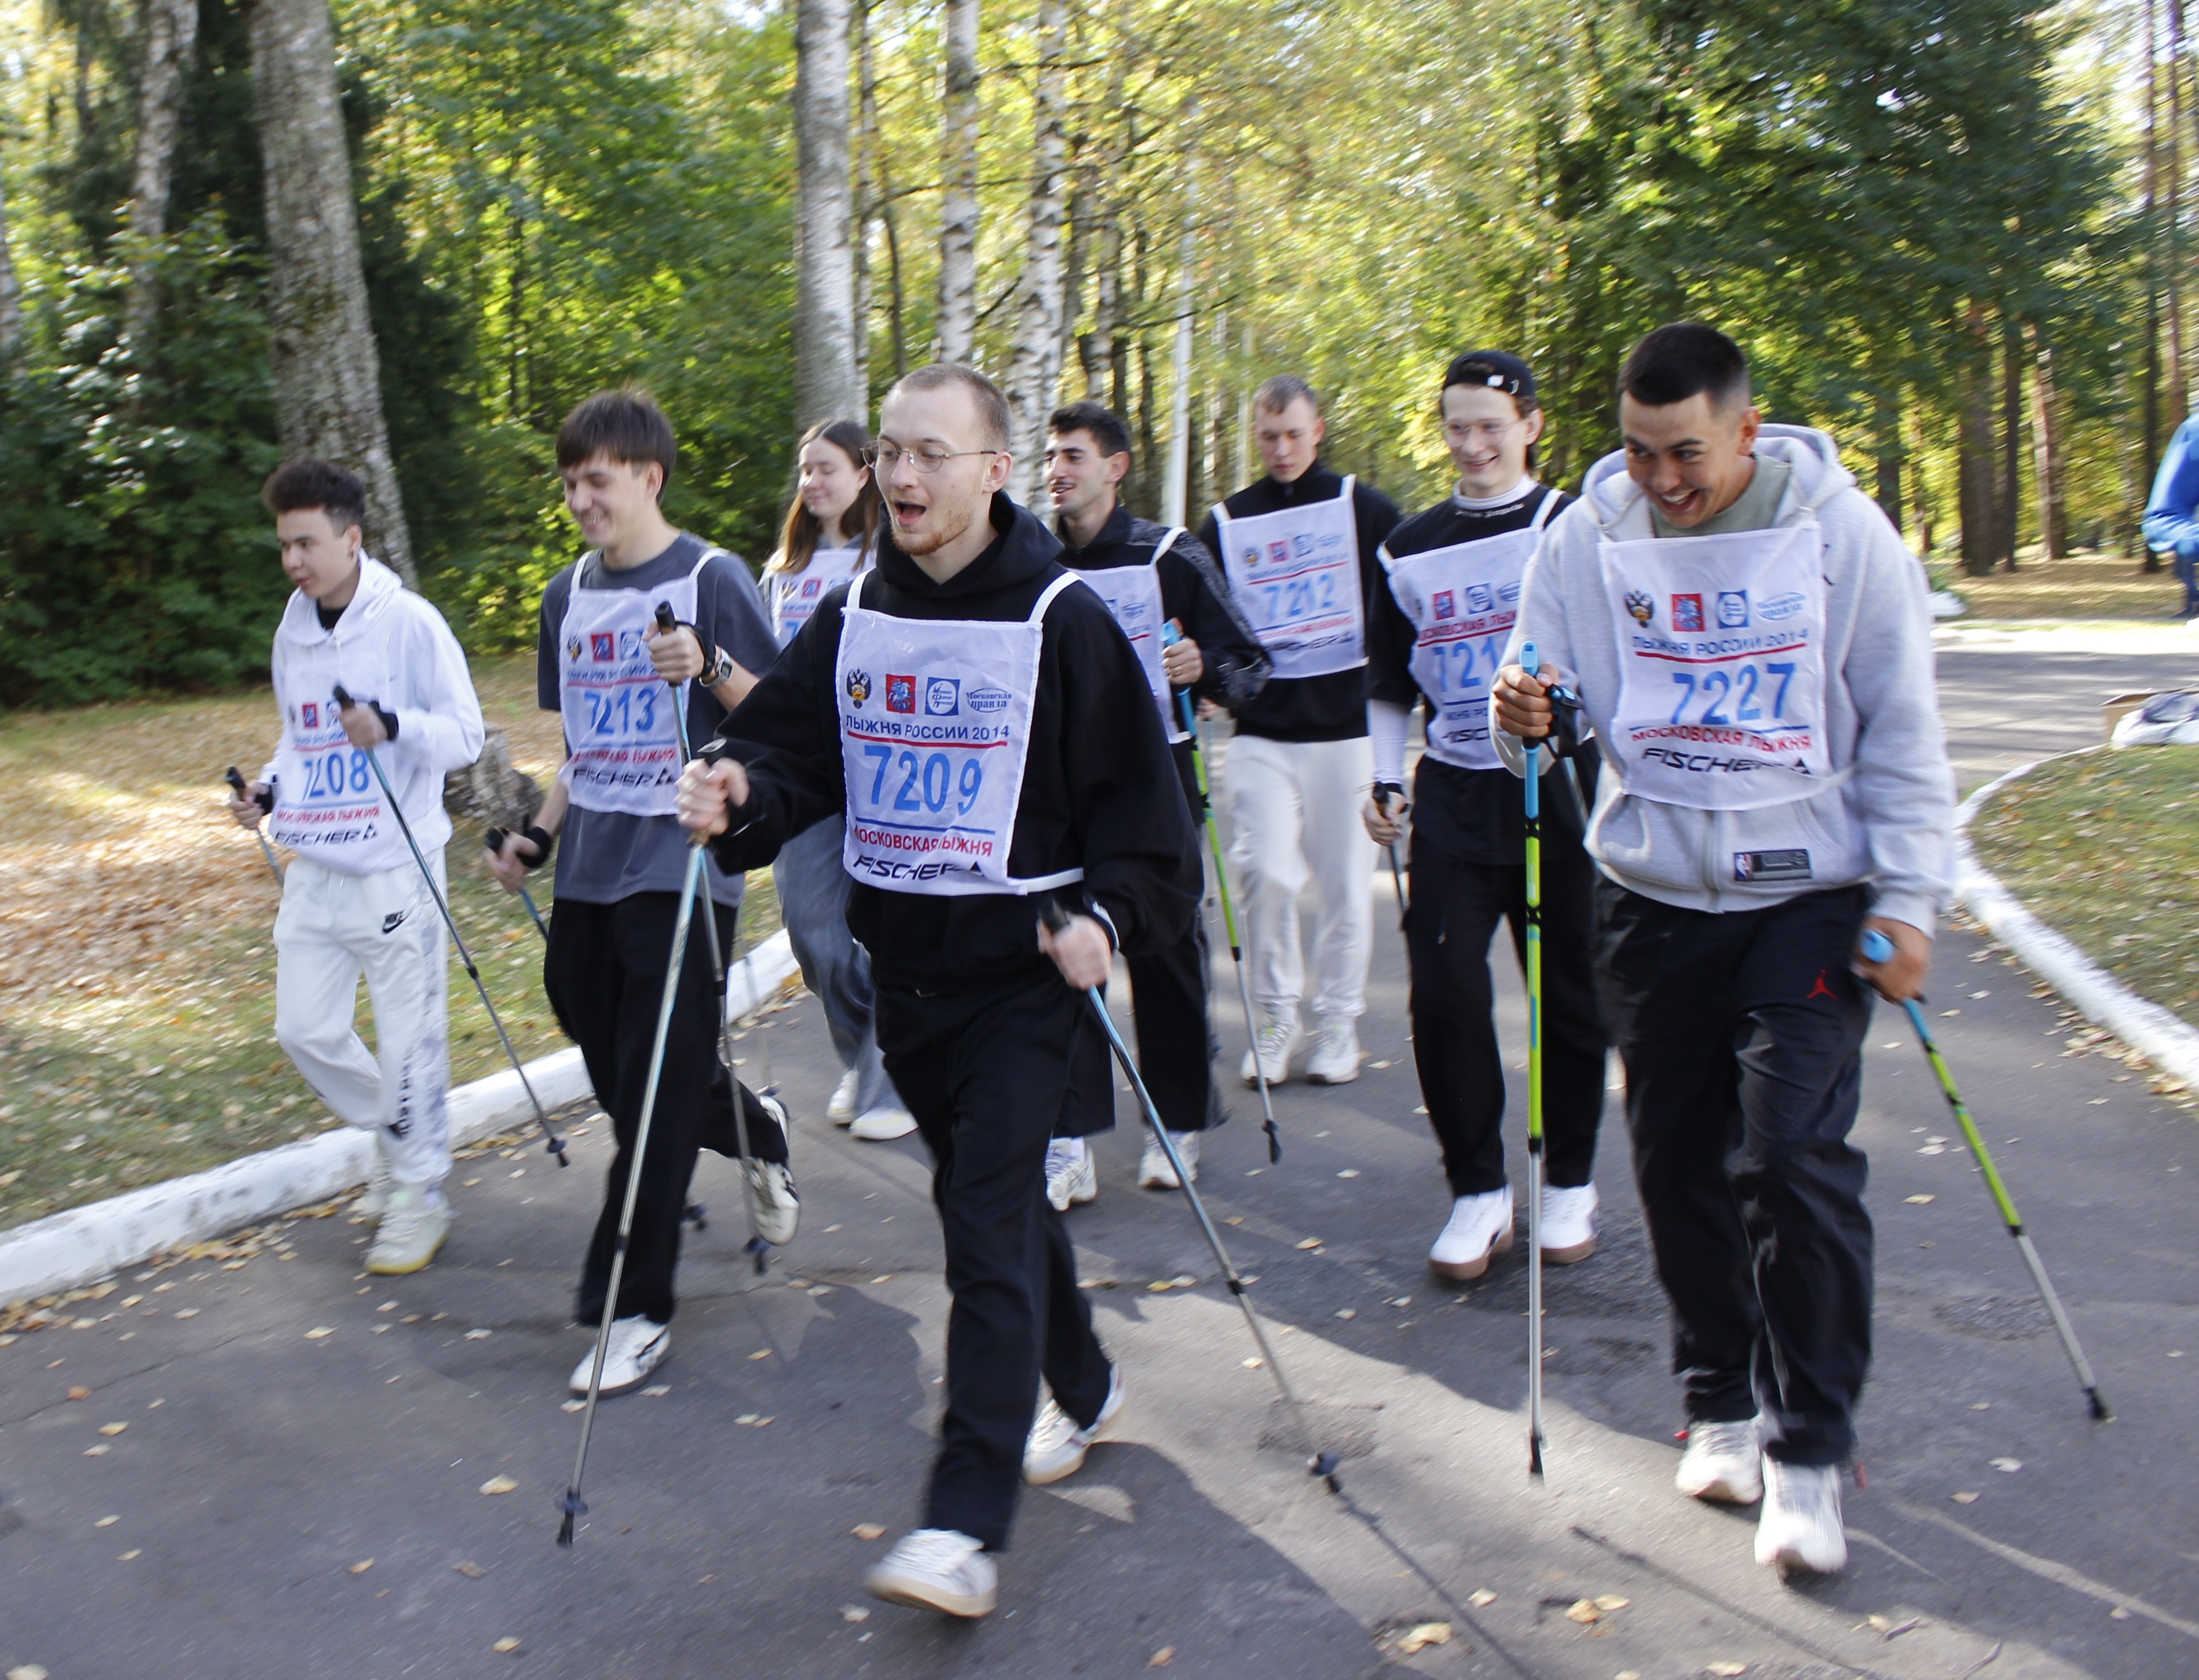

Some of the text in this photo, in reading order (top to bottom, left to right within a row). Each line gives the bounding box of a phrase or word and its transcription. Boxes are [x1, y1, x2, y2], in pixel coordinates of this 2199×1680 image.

[1263, 573, 1334, 621] 7212
[1766, 628, 1809, 646] 2014
[1433, 636, 1500, 692] 721
[584, 687, 655, 734] 7213
[1671, 663, 1796, 726] 7227
[846, 715, 1009, 740] ЛЫЖНЯ РОССИИ 2014
[1631, 725, 1745, 744] МОСКОВСКАЯ
[302, 747, 369, 803] 7208
[864, 745, 982, 816] 7209
